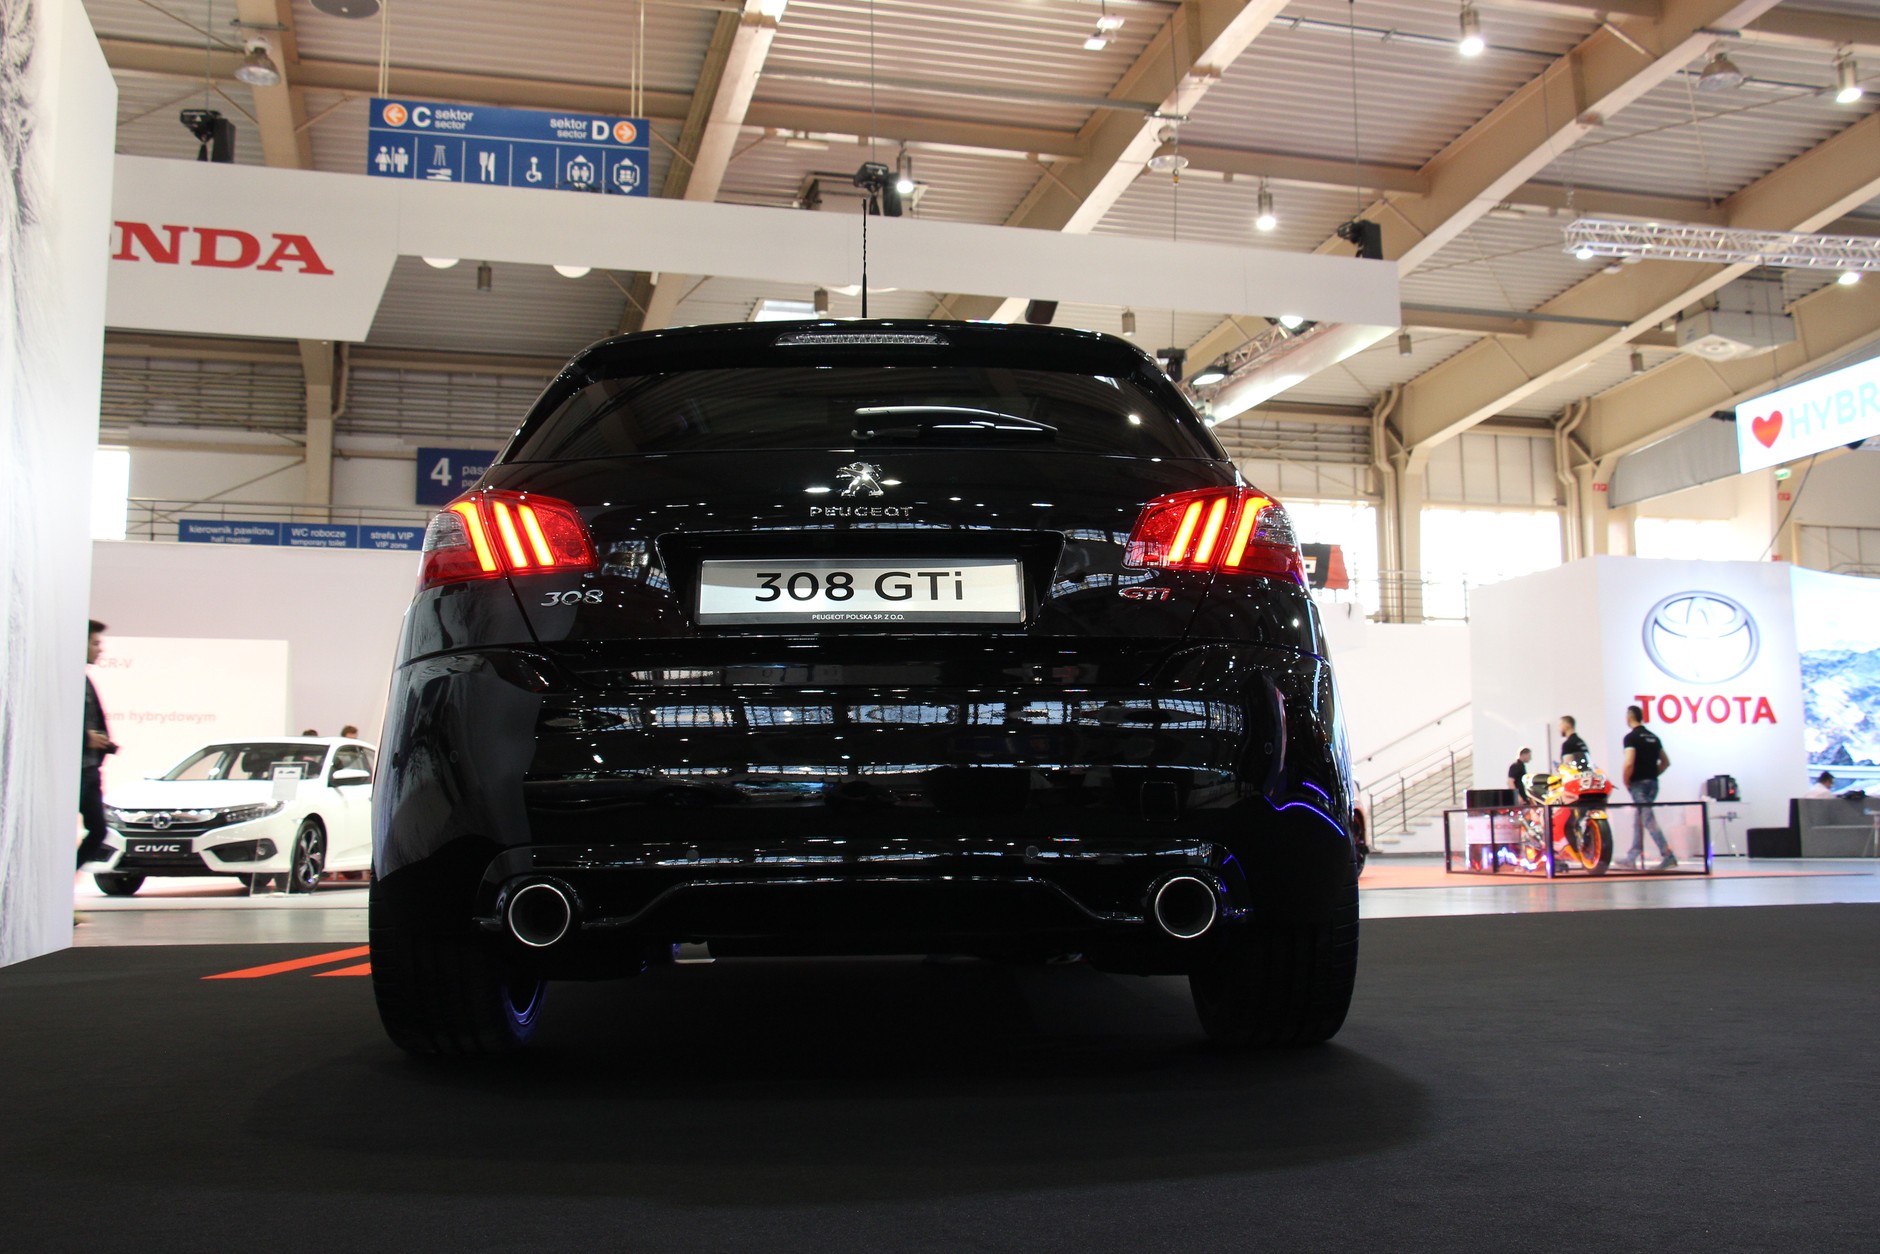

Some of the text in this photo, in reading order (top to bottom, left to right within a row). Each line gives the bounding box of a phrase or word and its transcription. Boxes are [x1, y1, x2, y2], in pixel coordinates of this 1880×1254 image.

[411, 106, 474, 128] C sektor
[434, 119, 466, 130] sector
[550, 117, 610, 141] sektor D
[557, 129, 587, 140] sector
[109, 221, 334, 275] NDA
[430, 457, 488, 487] 4 pas
[810, 506, 914, 517] PEUGEOT
[189, 525, 275, 537] kierownik pawilonu
[291, 528, 347, 539] WC robocze
[370, 531, 414, 541] strefa VIP
[290, 538, 346, 547] temporary toilet
[376, 541, 388, 549] VIP
[754, 571, 964, 602] 308 GTi
[540, 589, 604, 607] 308
[1634, 694, 1778, 724] TOYOTA
[129, 710, 217, 724] hybrydowym
[134, 844, 181, 853] CIVIC
